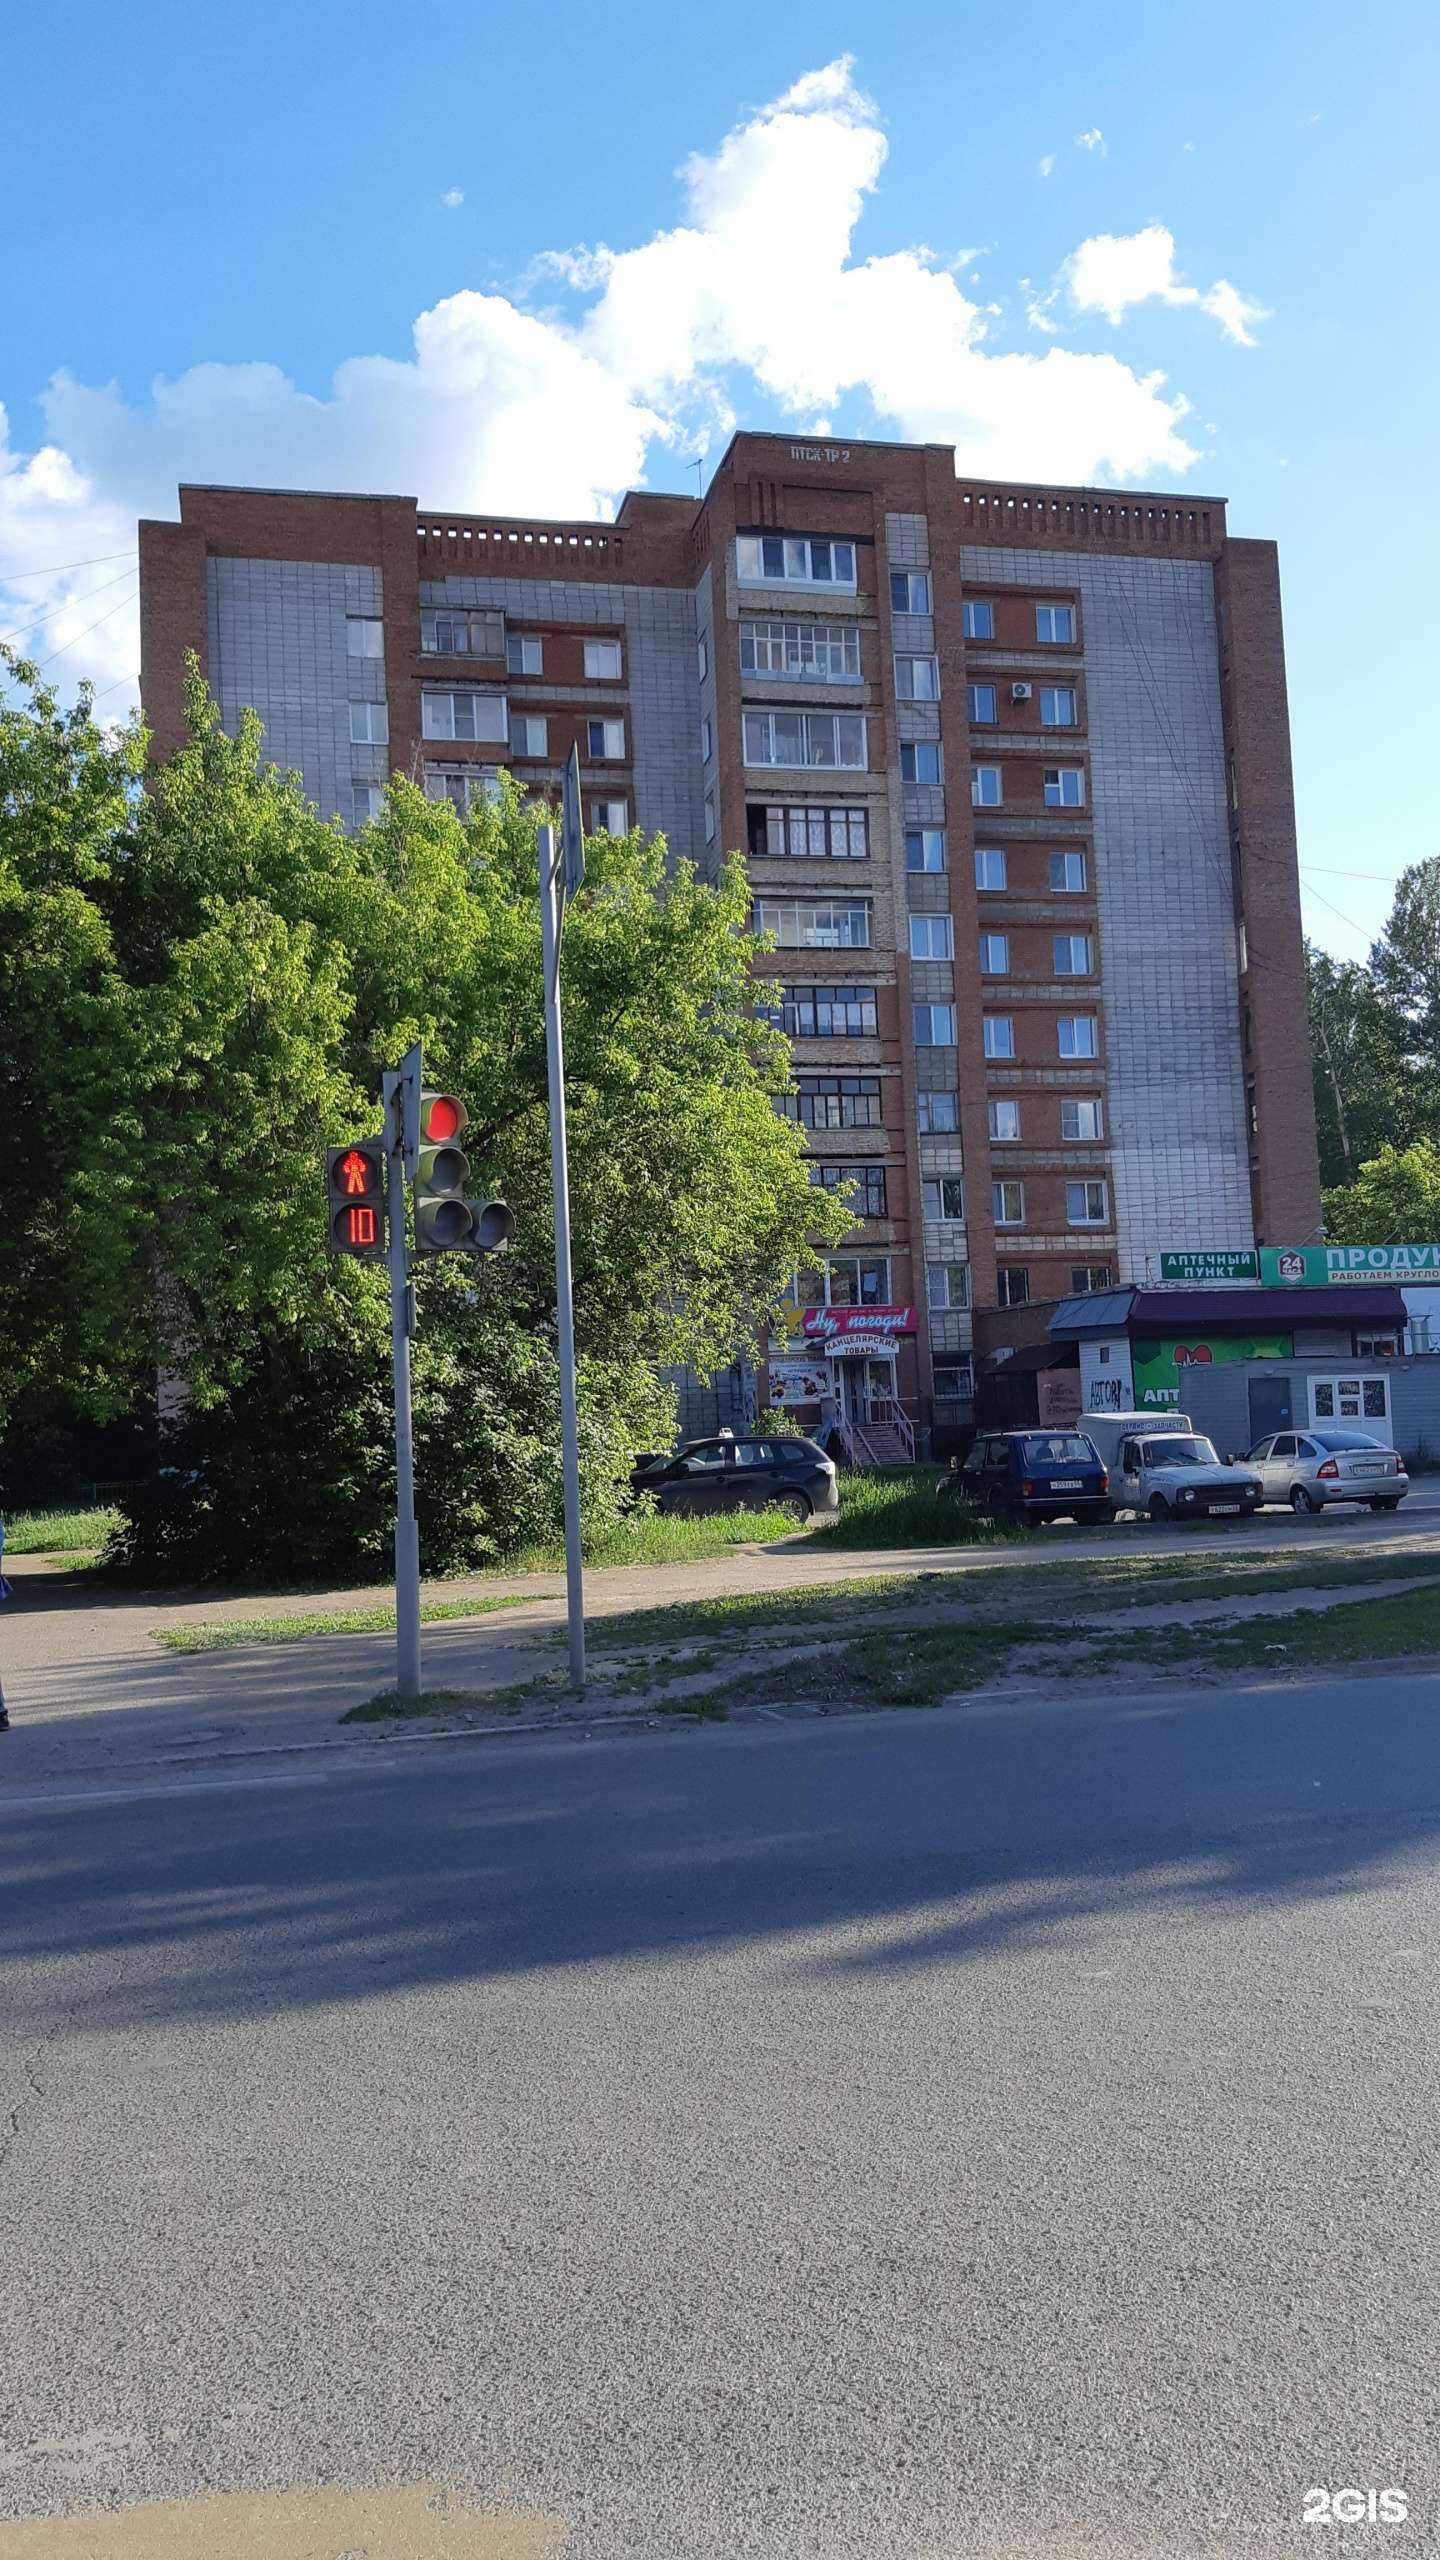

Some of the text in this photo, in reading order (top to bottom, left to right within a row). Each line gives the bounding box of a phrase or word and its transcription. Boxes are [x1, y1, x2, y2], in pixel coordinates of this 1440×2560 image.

[842, 450, 850, 464] 2
[350, 1208, 375, 1243] 10
[1167, 1252, 1250, 1266] АПТЕЧНЫЙ
[1282, 1256, 1302, 1269] 24
[1184, 1266, 1234, 1278] ПУНКТ
[1331, 1271, 1392, 1280] РАБОТАЕМ
[806, 1307, 910, 1336] Ну, погоди!
[826, 1334, 897, 1351] КАНЦЕЛЯРСКИЕ
[844, 1346, 879, 1355] ТОВАРЫ
